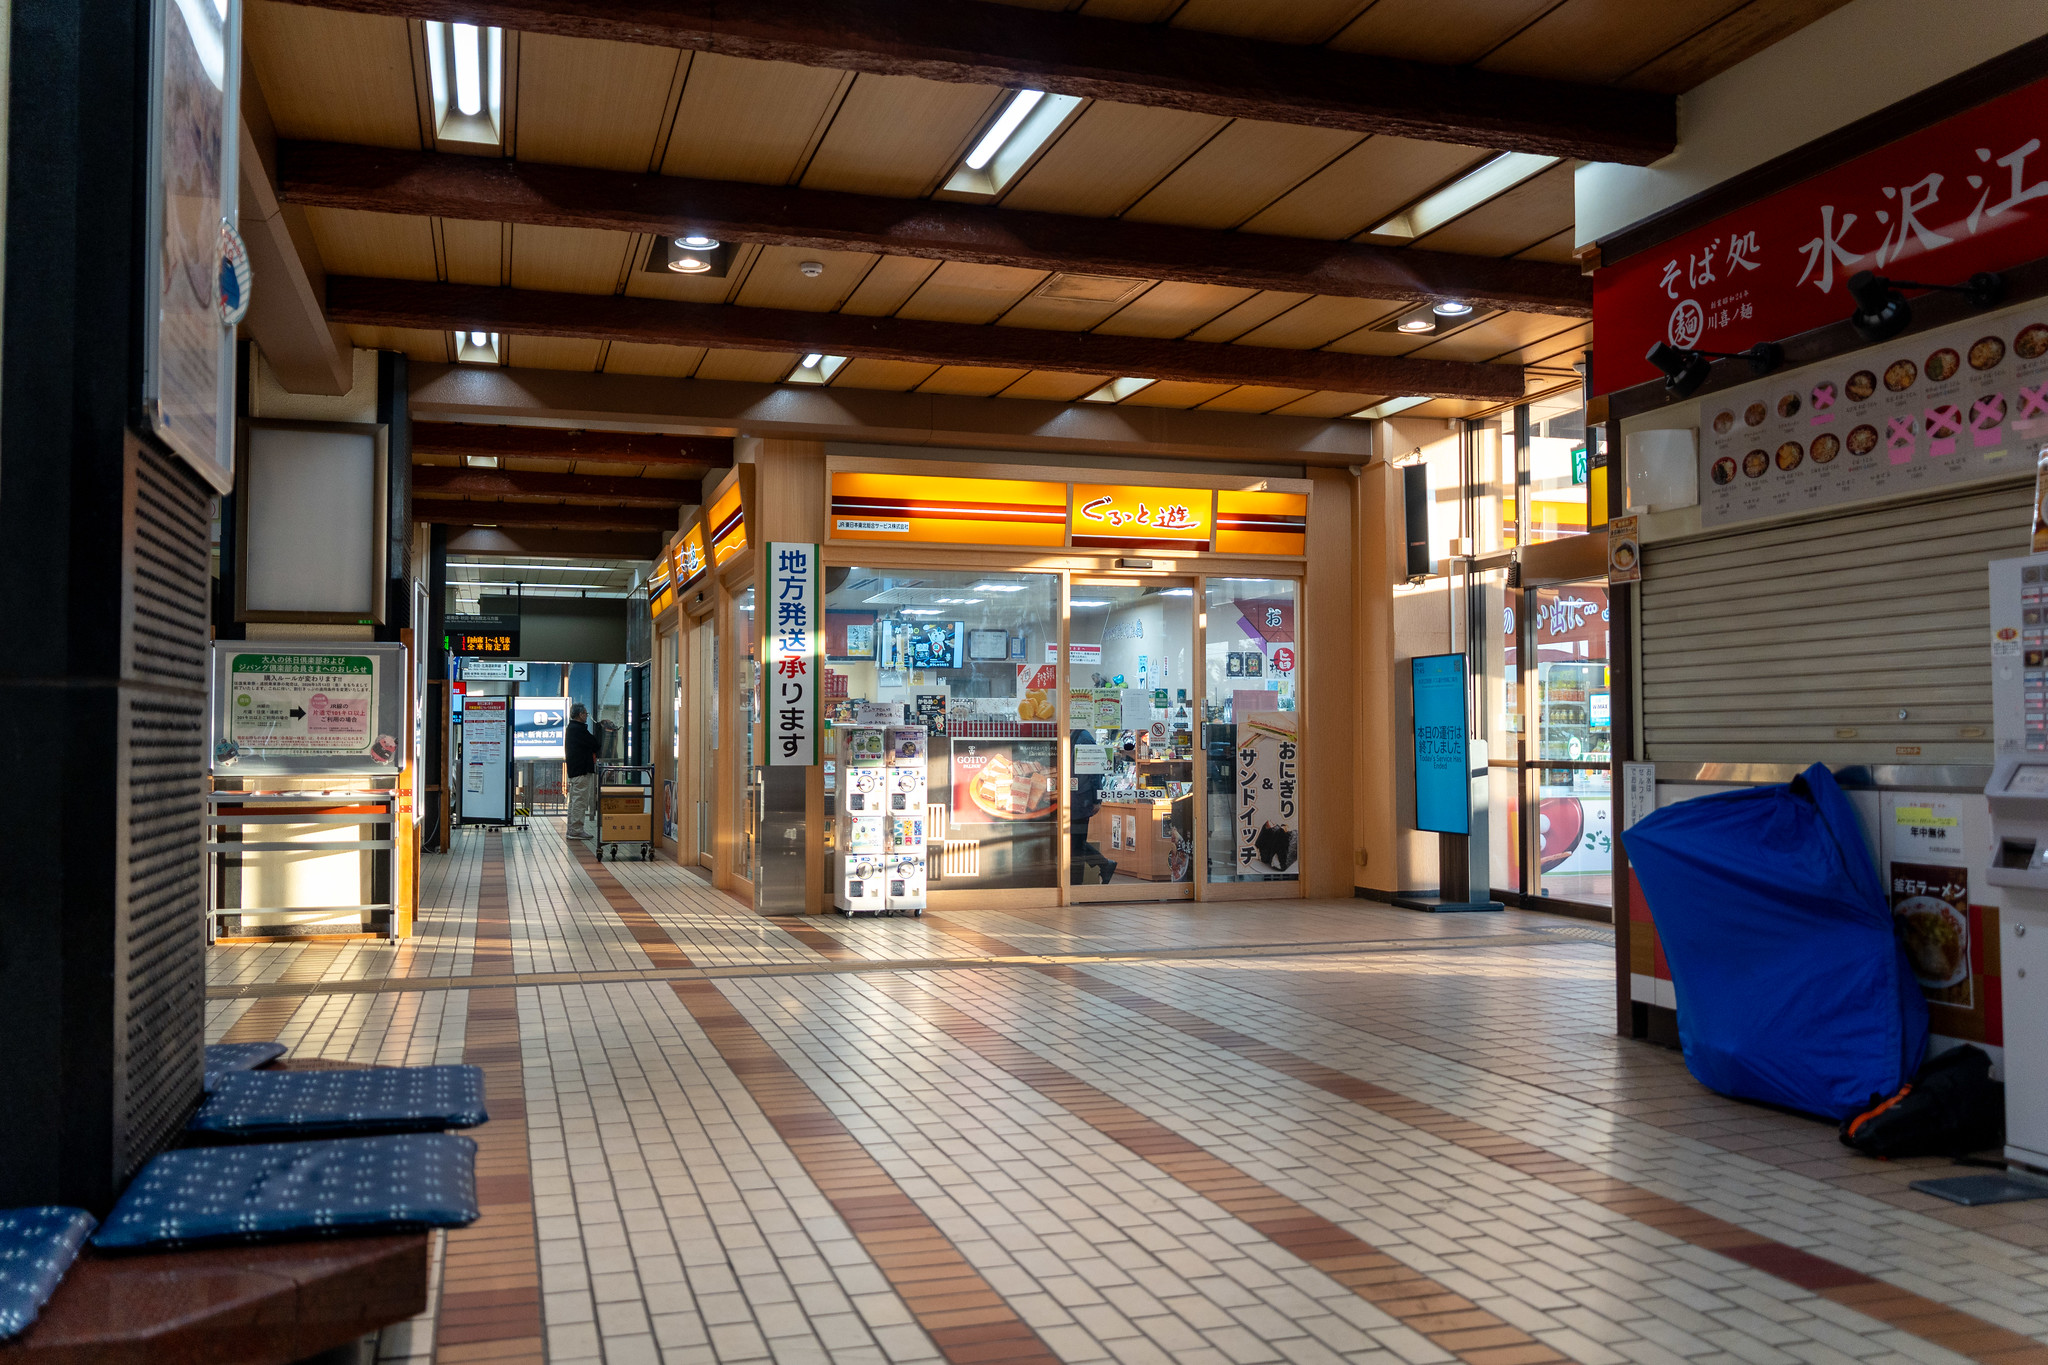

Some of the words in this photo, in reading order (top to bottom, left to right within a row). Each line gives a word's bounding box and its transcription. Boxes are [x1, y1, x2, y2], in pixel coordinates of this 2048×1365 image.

[1659, 231, 1761, 299] そば処
[1081, 495, 1200, 530] ぐるっと遊
[1266, 608, 1282, 627] お
[778, 549, 807, 757] 地方発送承ります
[1417, 726, 1462, 740] 本日の運行は
[1418, 740, 1461, 754] 終了しました
[957, 756, 987, 764] GOTTO
[1262, 778, 1273, 790] &
[1279, 741, 1296, 819] おにぎり
[1239, 749, 1257, 865] サンドイッチ
[1910, 826, 1946, 838] 年中無休
[1894, 878, 1966, 898] 釜石ラーメン
